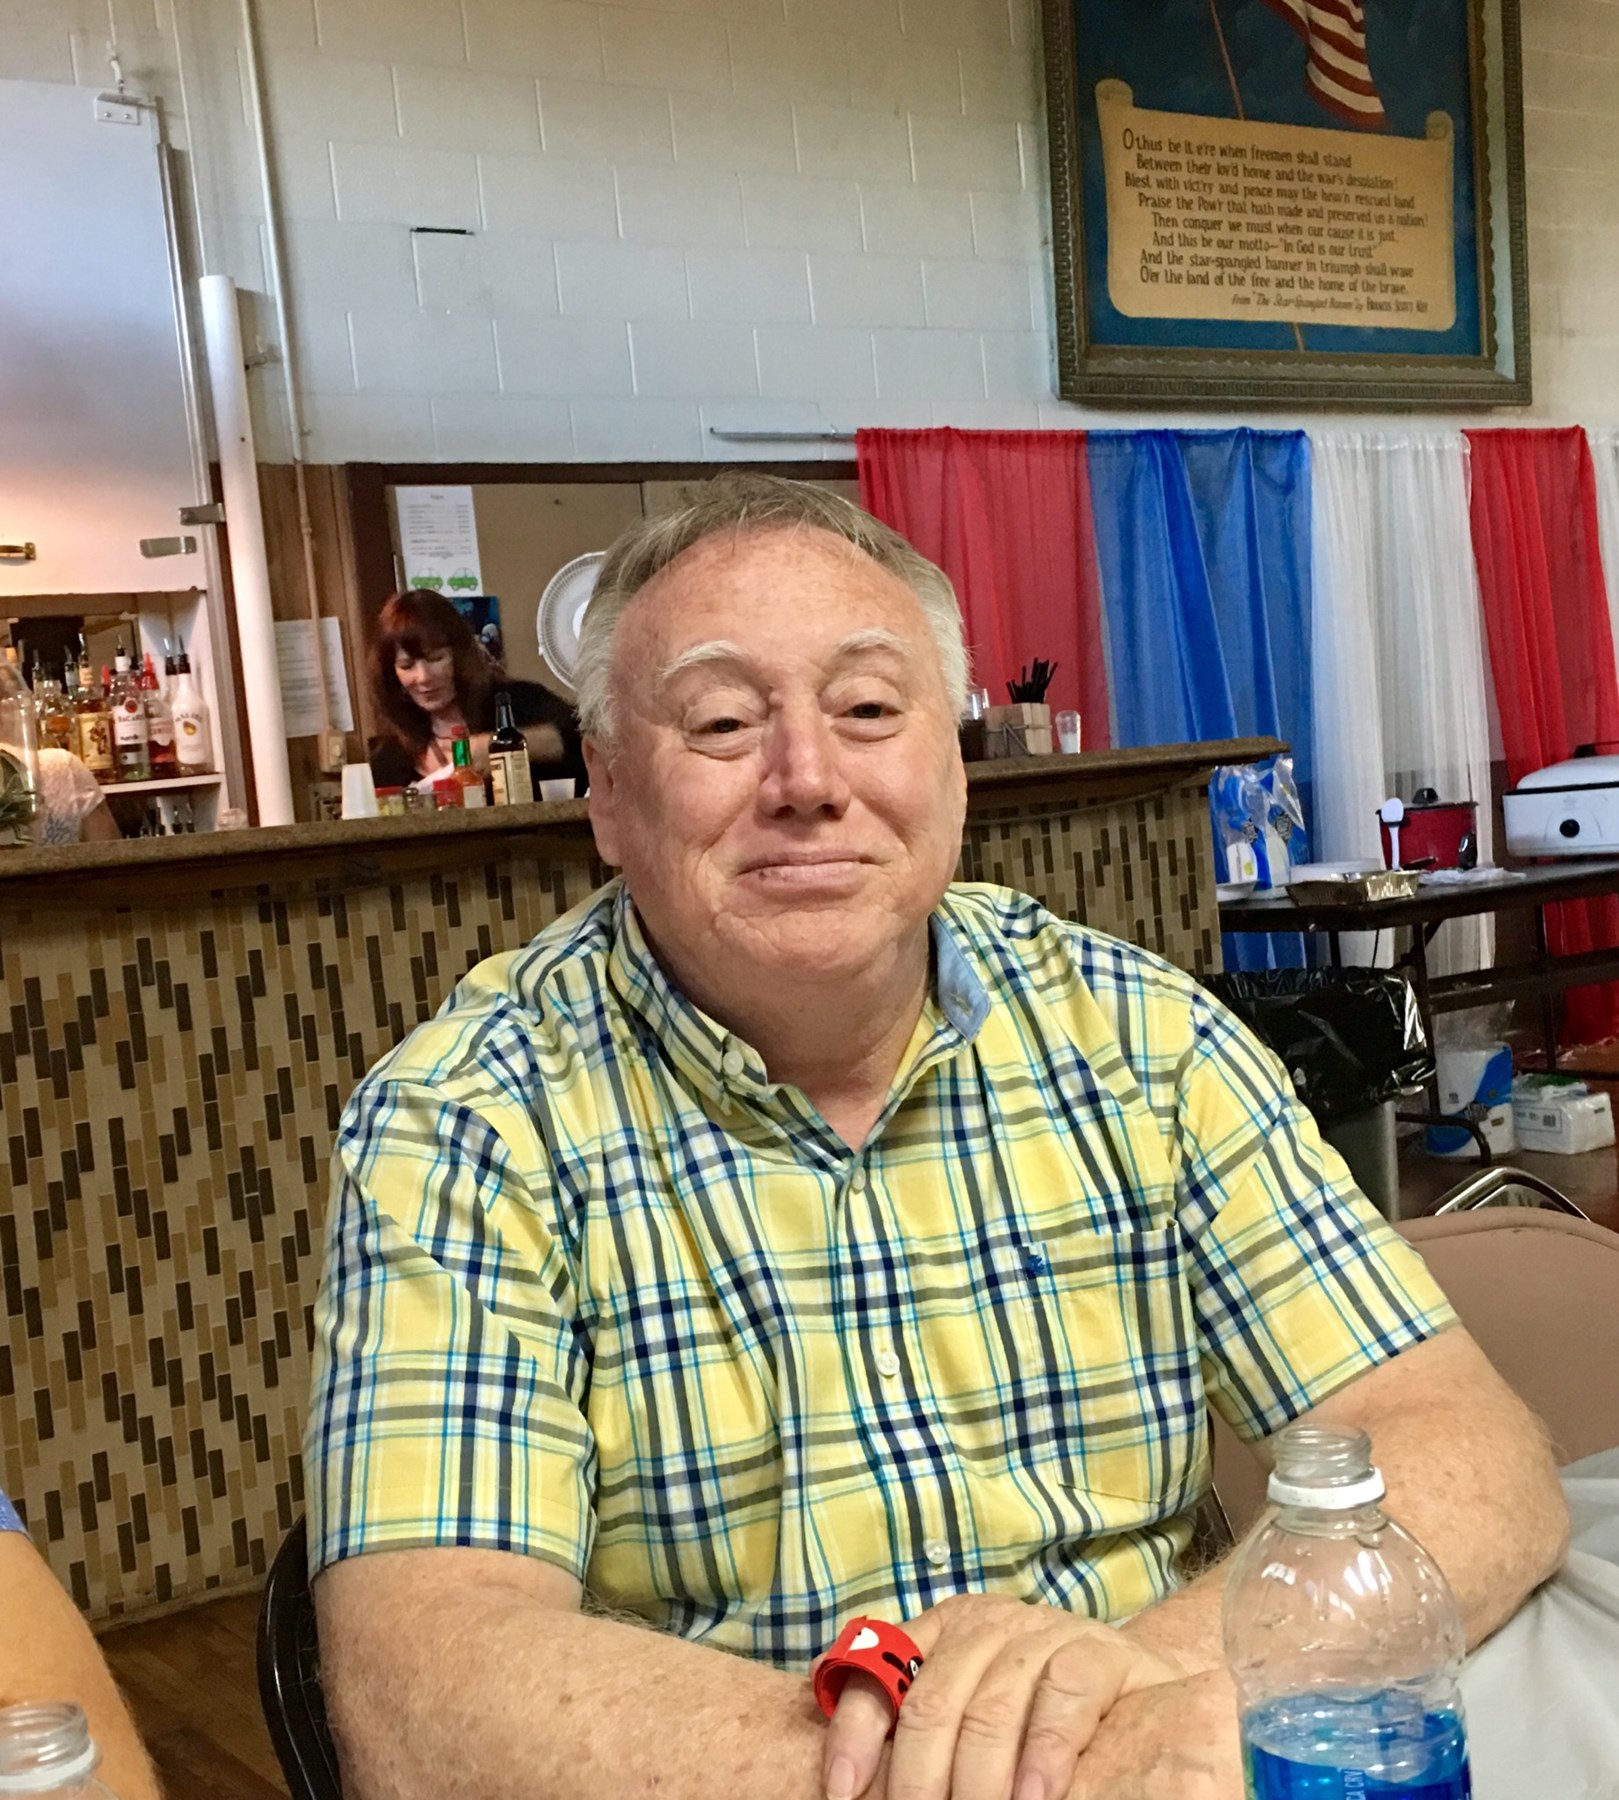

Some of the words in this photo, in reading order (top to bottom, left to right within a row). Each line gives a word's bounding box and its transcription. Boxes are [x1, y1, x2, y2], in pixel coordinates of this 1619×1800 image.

[1123, 128, 1134, 149] O
[1136, 137, 1162, 151] thus
[1168, 140, 1181, 153] be
[1185, 140, 1193, 154] it
[1220, 145, 1247, 158] when
[1252, 145, 1292, 162] freemen
[1297, 150, 1318, 165] shall
[1323, 155, 1352, 168] stand
[1137, 154, 1182, 172] Between
[1187, 161, 1212, 174] their
[1243, 165, 1271, 180] home
[1276, 169, 1294, 181] and
[1297, 170, 1314, 183] the
[1318, 172, 1343, 185] war's
[1125, 171, 1152, 188] Blest
[1156, 176, 1179, 190] with
[1219, 183, 1238, 195] and
[1243, 185, 1273, 199] peace
[1277, 188, 1298, 201] may
[1302, 188, 1317, 200] the
[1355, 194, 1390, 207] rescued
[1394, 195, 1415, 209] land
[1138, 192, 1172, 208] Praise
[1177, 195, 1193, 210] the
[1227, 201, 1247, 214] that
[1252, 202, 1274, 215] hath
[1278, 205, 1302, 217] made
[1306, 206, 1323, 218] and
[1328, 210, 1370, 223] preserved
[1374, 212, 1385, 224] us
[1389, 214, 1393, 224] a
[1152, 212, 1178, 228] Then
[1182, 216, 1223, 232] conquer
[1228, 220, 1242, 231] we
[1246, 220, 1272, 233] must
[1277, 223, 1302, 235] when
[1308, 226, 1323, 236] our
[1328, 228, 1354, 239] cause
[1358, 228, 1363, 239] it
[1367, 229, 1374, 241] is
[1153, 231, 1173, 247] And
[1178, 233, 1197, 248] this
[1202, 236, 1212, 247] be
[1217, 239, 1234, 249] our
[1297, 240, 1315, 253] God
[1318, 245, 1325, 255] is
[1329, 245, 1344, 256] our
[1141, 249, 1162, 264] And
[1167, 251, 1183, 265] the
[1190, 254, 1261, 272] star-spangled
[1266, 257, 1303, 272] banner
[1307, 258, 1316, 272] in
[1320, 261, 1361, 276] triumph
[1365, 262, 1386, 275] shall
[1390, 266, 1413, 277] wave
[1165, 270, 1182, 284] the
[1187, 271, 1209, 285] land
[1215, 272, 1225, 285] of
[1228, 274, 1245, 286] the
[1252, 272, 1270, 287] free
[1275, 277, 1294, 289] and
[1299, 277, 1315, 290] the
[1319, 277, 1344, 291] home
[1349, 280, 1357, 291] of
[1362, 280, 1376, 292] the
[1344, 1771, 1365, 1788] CRV
